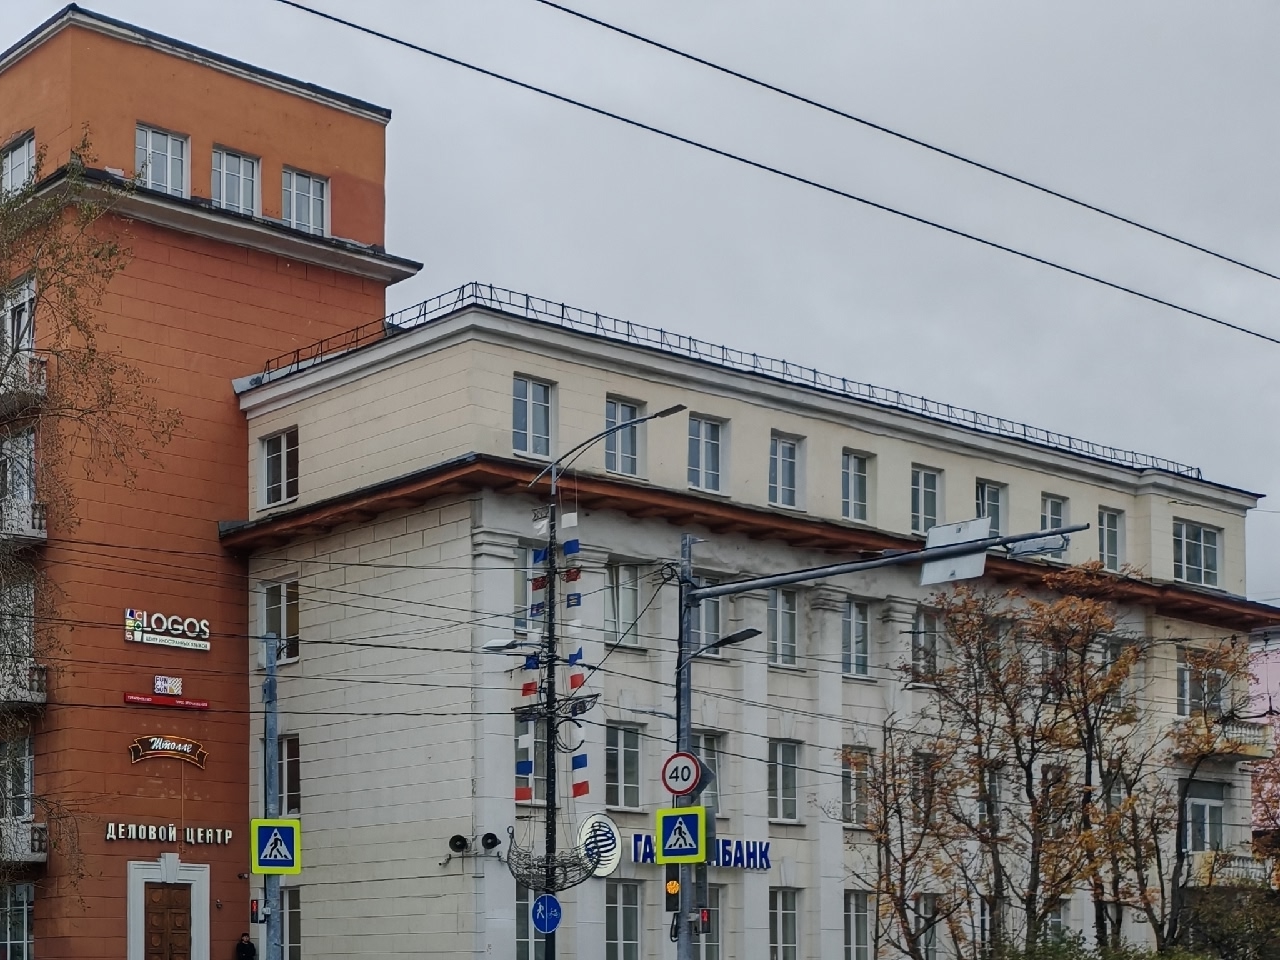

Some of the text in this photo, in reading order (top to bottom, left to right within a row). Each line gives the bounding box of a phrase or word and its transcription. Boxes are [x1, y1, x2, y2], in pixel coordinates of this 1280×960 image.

[143, 611, 209, 638] LOGOS
[669, 766, 691, 781] 40
[106, 822, 233, 845] ДЕЛОВОЙ ЦЕНТР
